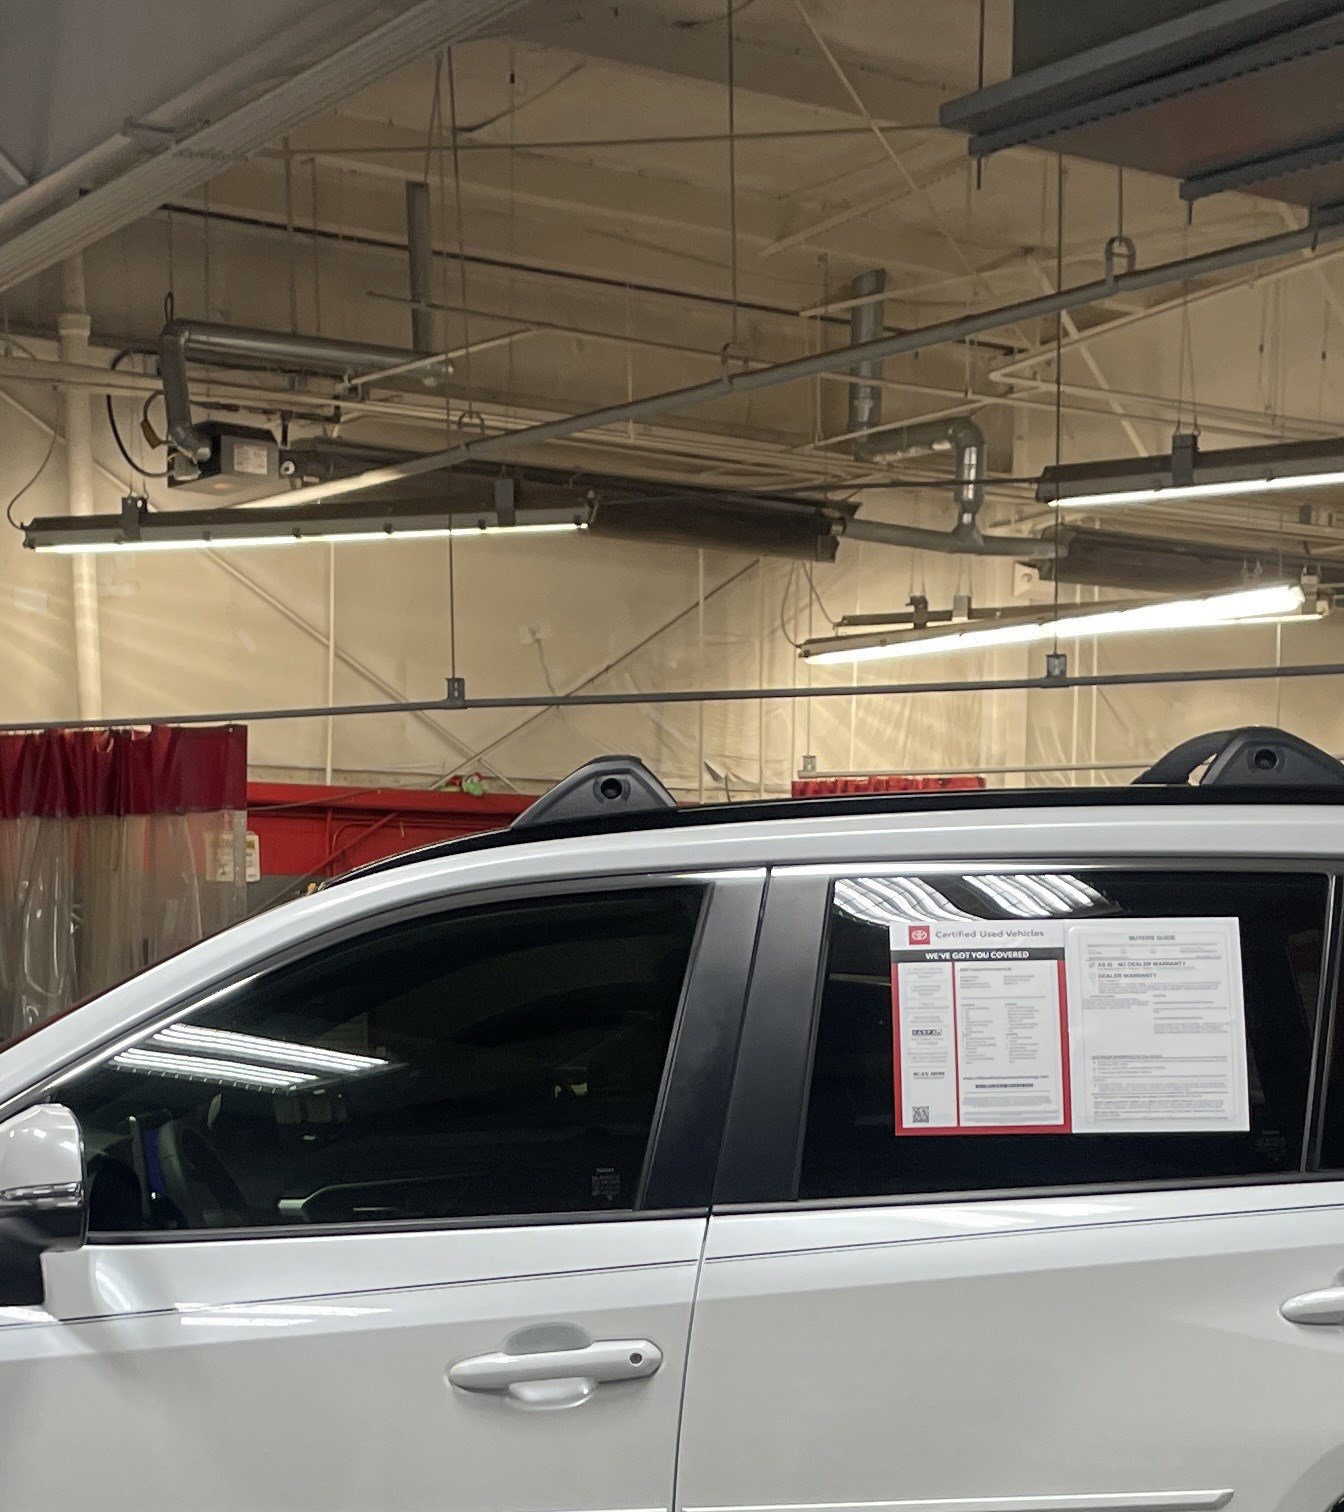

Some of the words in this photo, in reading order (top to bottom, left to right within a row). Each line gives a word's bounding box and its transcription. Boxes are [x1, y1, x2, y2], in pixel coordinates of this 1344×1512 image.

[935, 929, 976, 939] Certified
[979, 929, 1003, 938] Used
[1006, 929, 1044, 938] Vehicles
[925, 952, 950, 960] WE'VE
[952, 951, 970, 960] GOT
[971, 951, 989, 960] YOU
[990, 950, 1029, 959] COVERED
